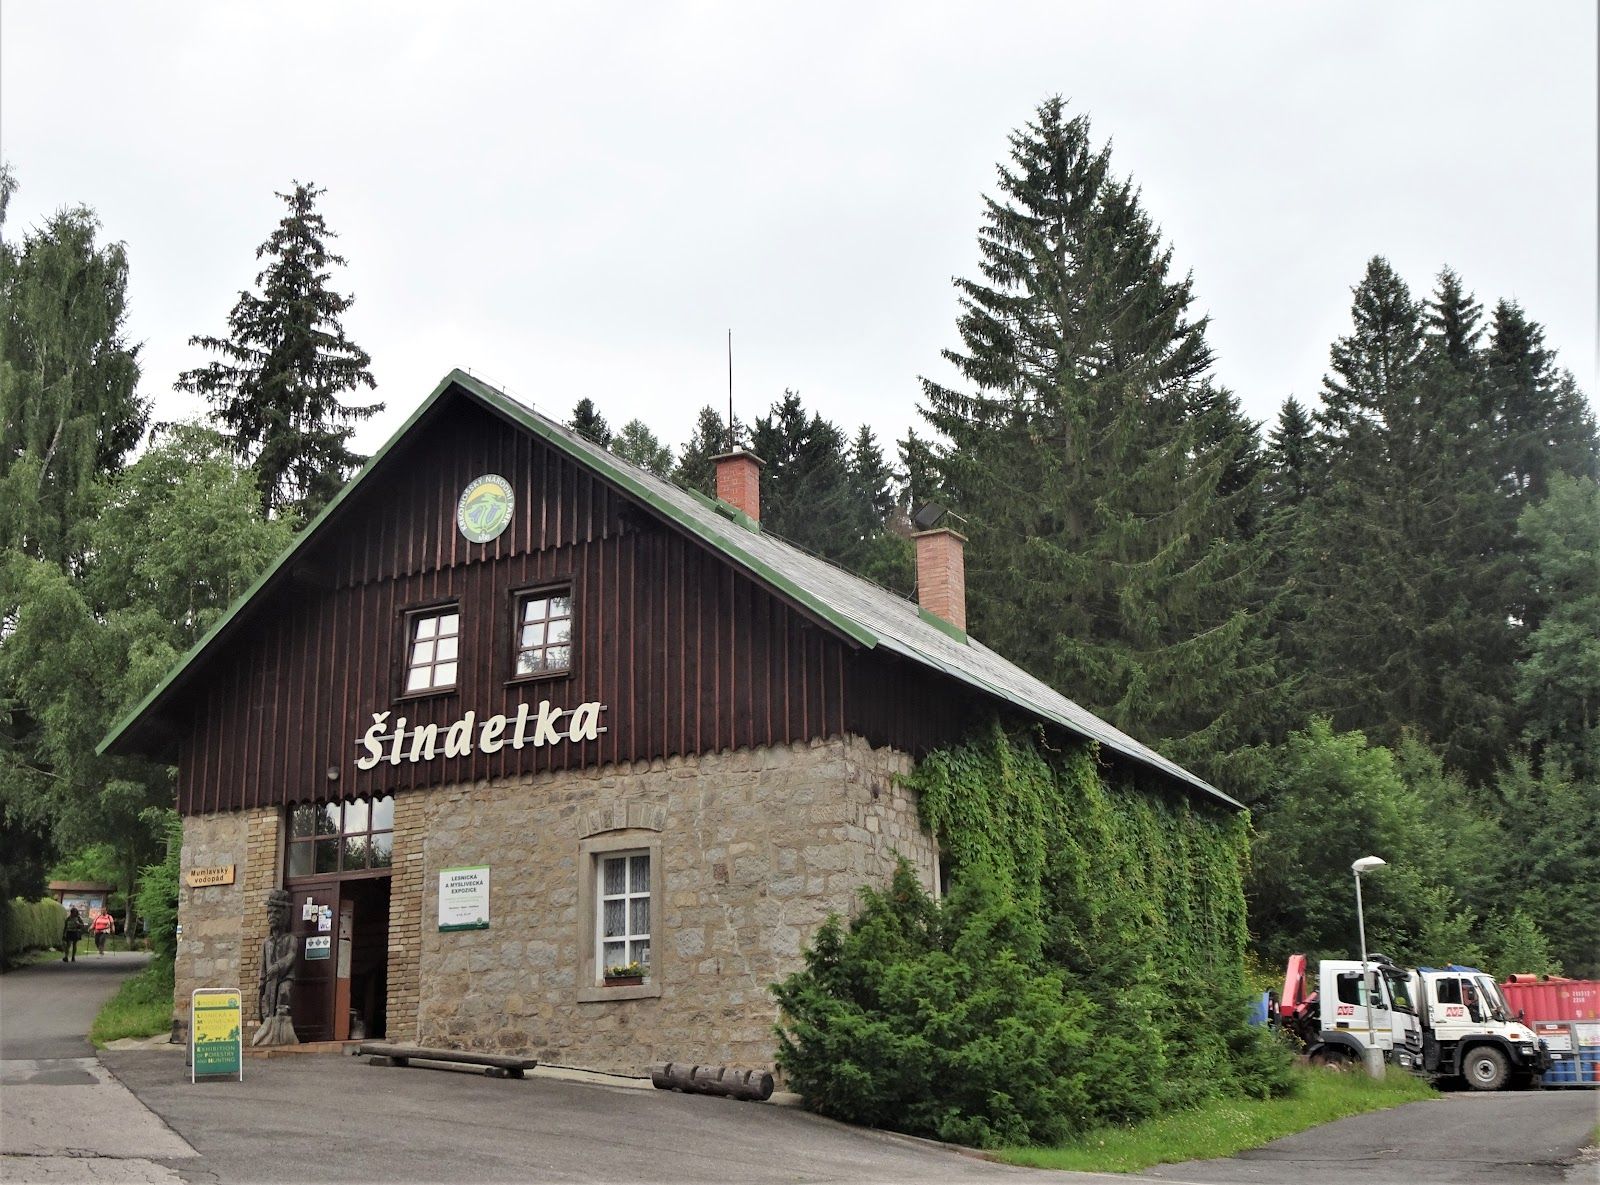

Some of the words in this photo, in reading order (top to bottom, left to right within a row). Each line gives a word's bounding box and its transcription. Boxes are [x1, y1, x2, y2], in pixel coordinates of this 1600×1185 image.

[502, 503, 513, 526] PARK
[357, 700, 601, 771] Šindelka
[191, 866, 228, 876] Mumlavský
[195, 875, 223, 883] vodopád
[1337, 1006, 1354, 1015] AVE
[1446, 1007, 1464, 1017] AVE
